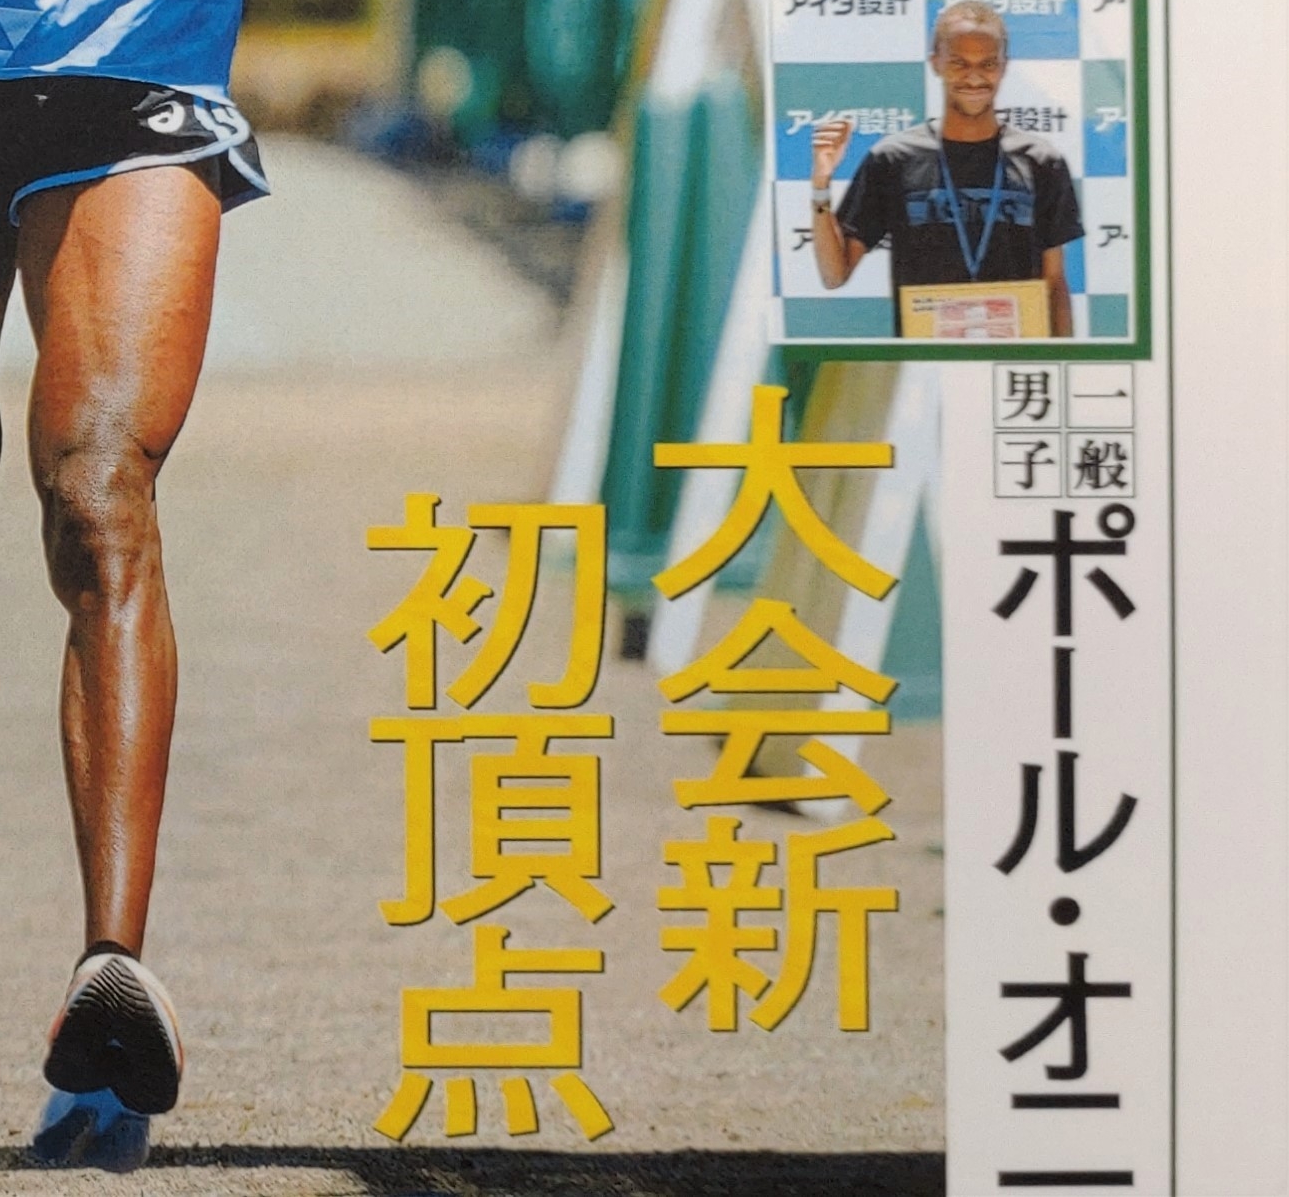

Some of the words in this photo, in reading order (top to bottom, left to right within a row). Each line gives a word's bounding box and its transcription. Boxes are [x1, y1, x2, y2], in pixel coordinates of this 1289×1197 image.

[365, 493, 615, 1141] 初頂点
[652, 385, 899, 1032] 大会新
